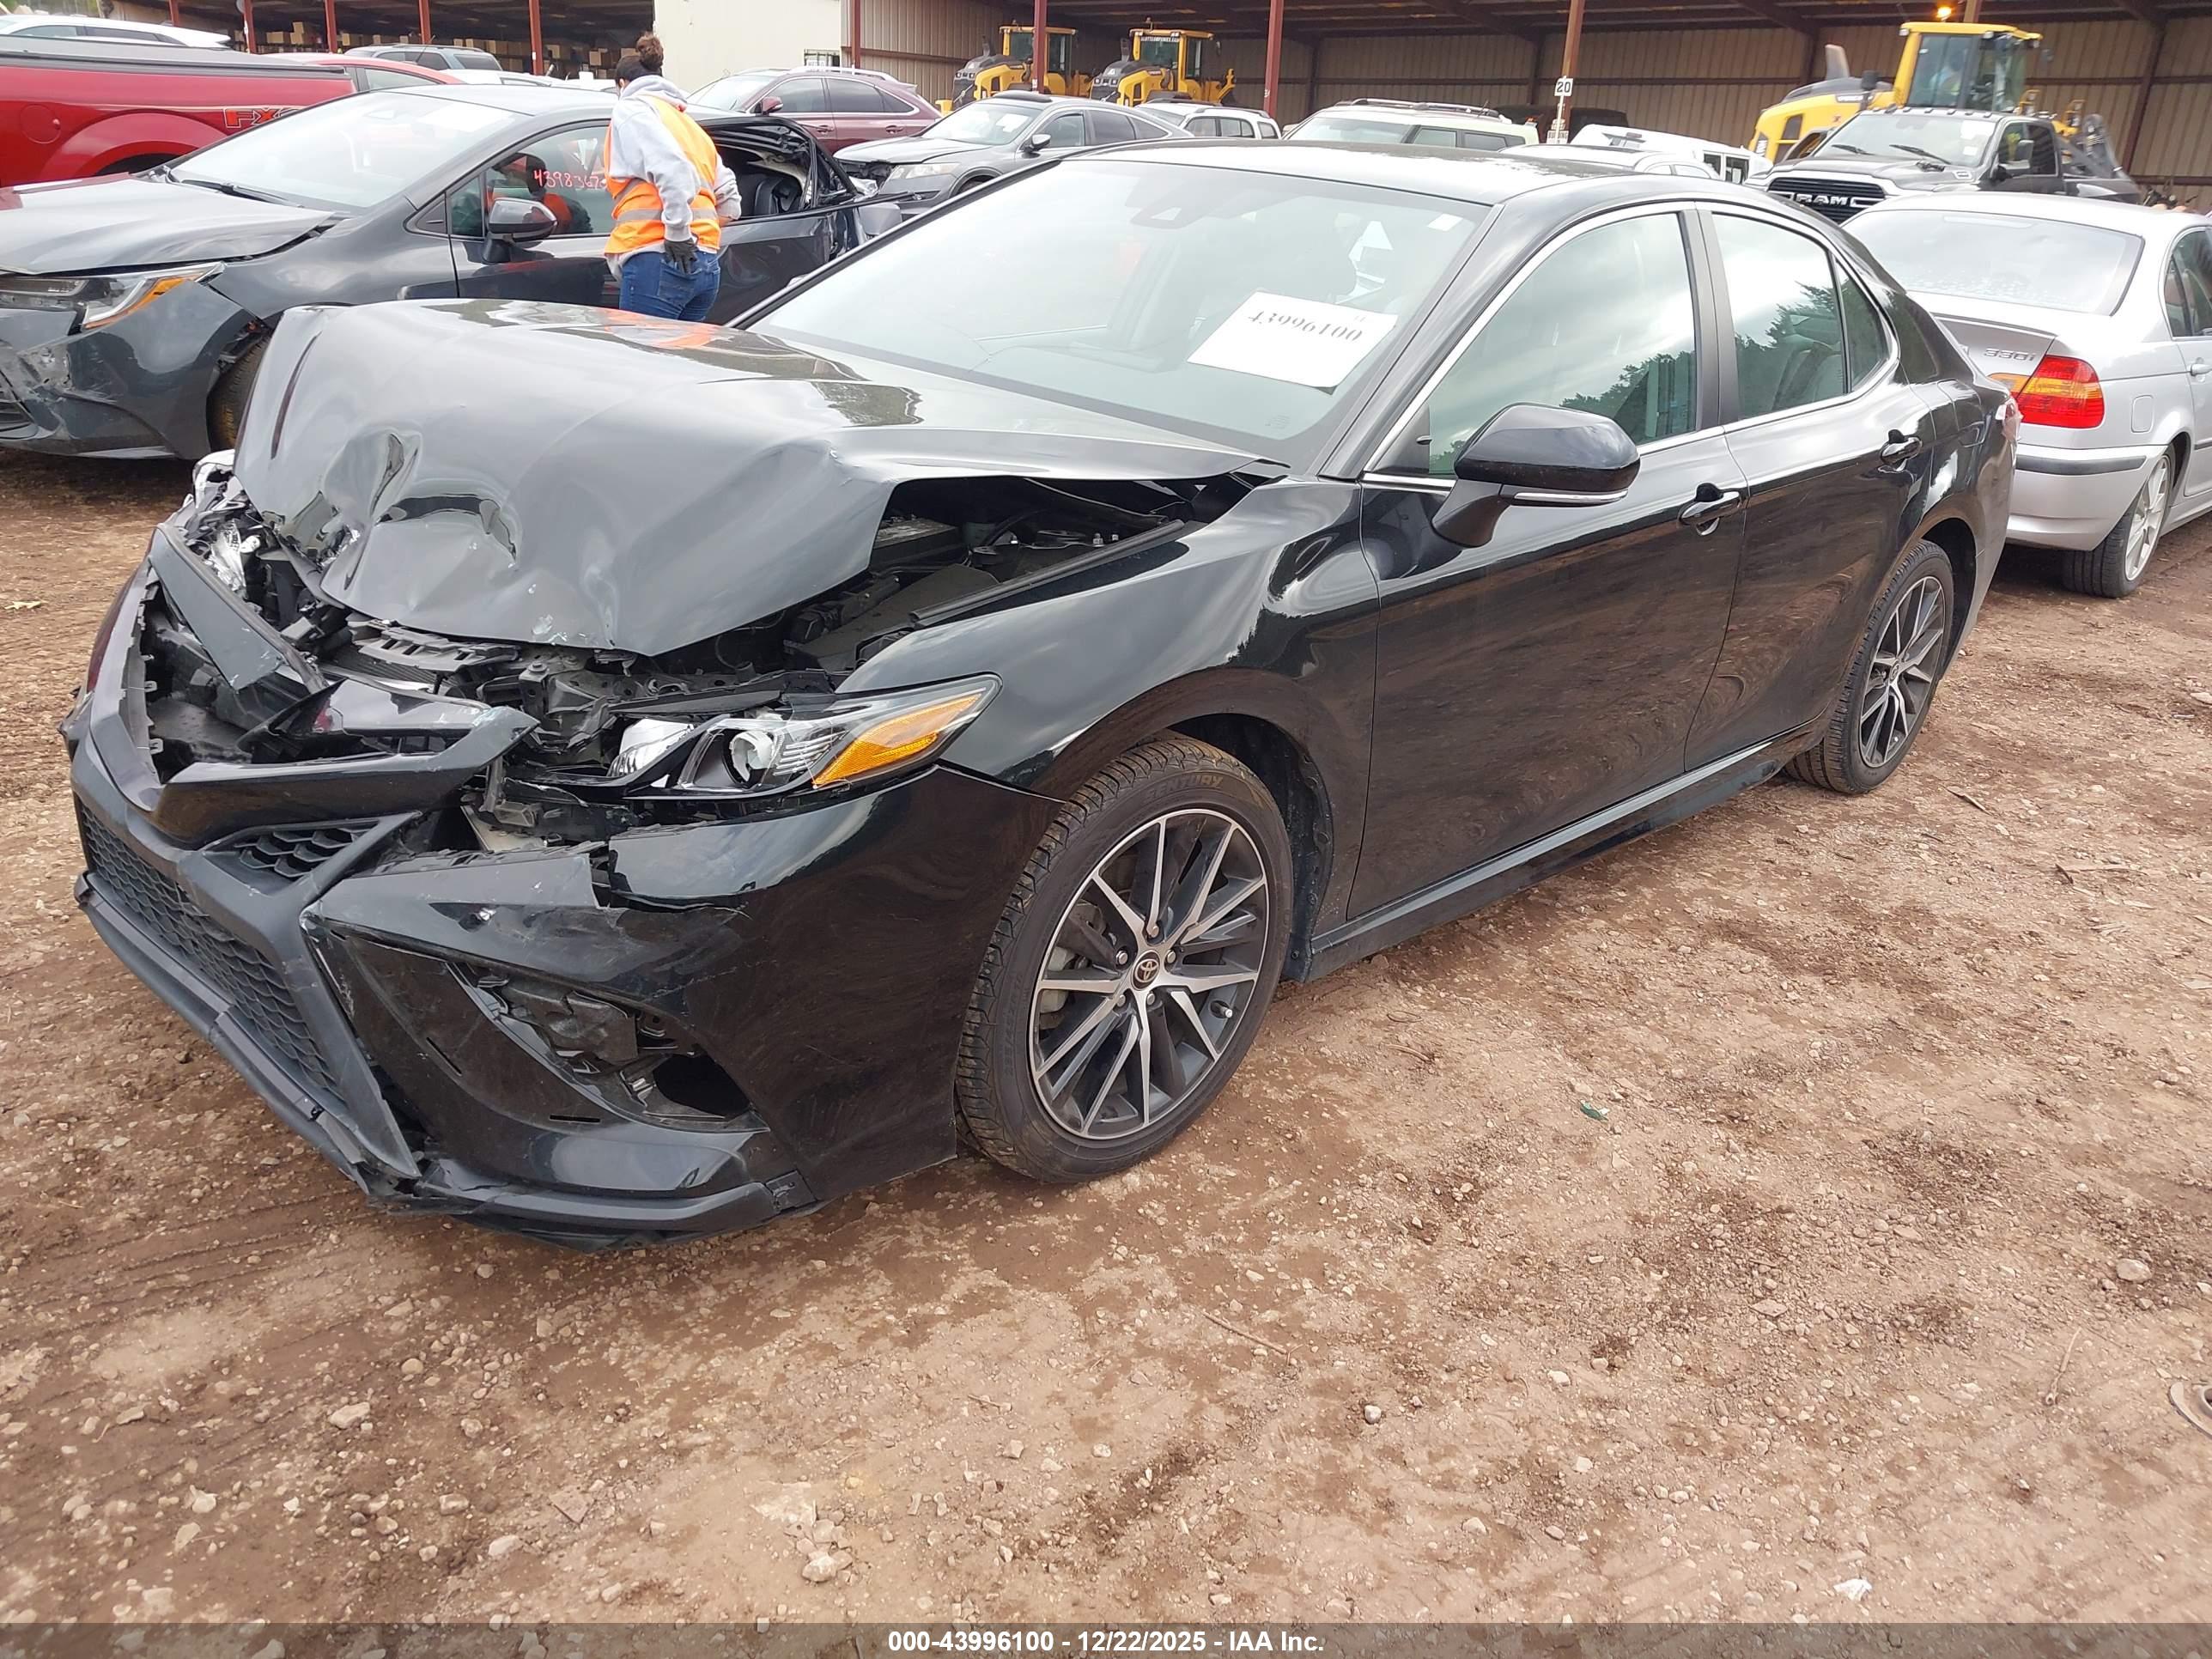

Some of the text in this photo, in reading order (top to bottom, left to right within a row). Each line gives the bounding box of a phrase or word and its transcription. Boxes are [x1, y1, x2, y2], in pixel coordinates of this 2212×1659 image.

[1556, 81, 1571, 93] 20
[1796, 193, 1849, 205] RAM
[1248, 310, 1363, 341] 43996100
